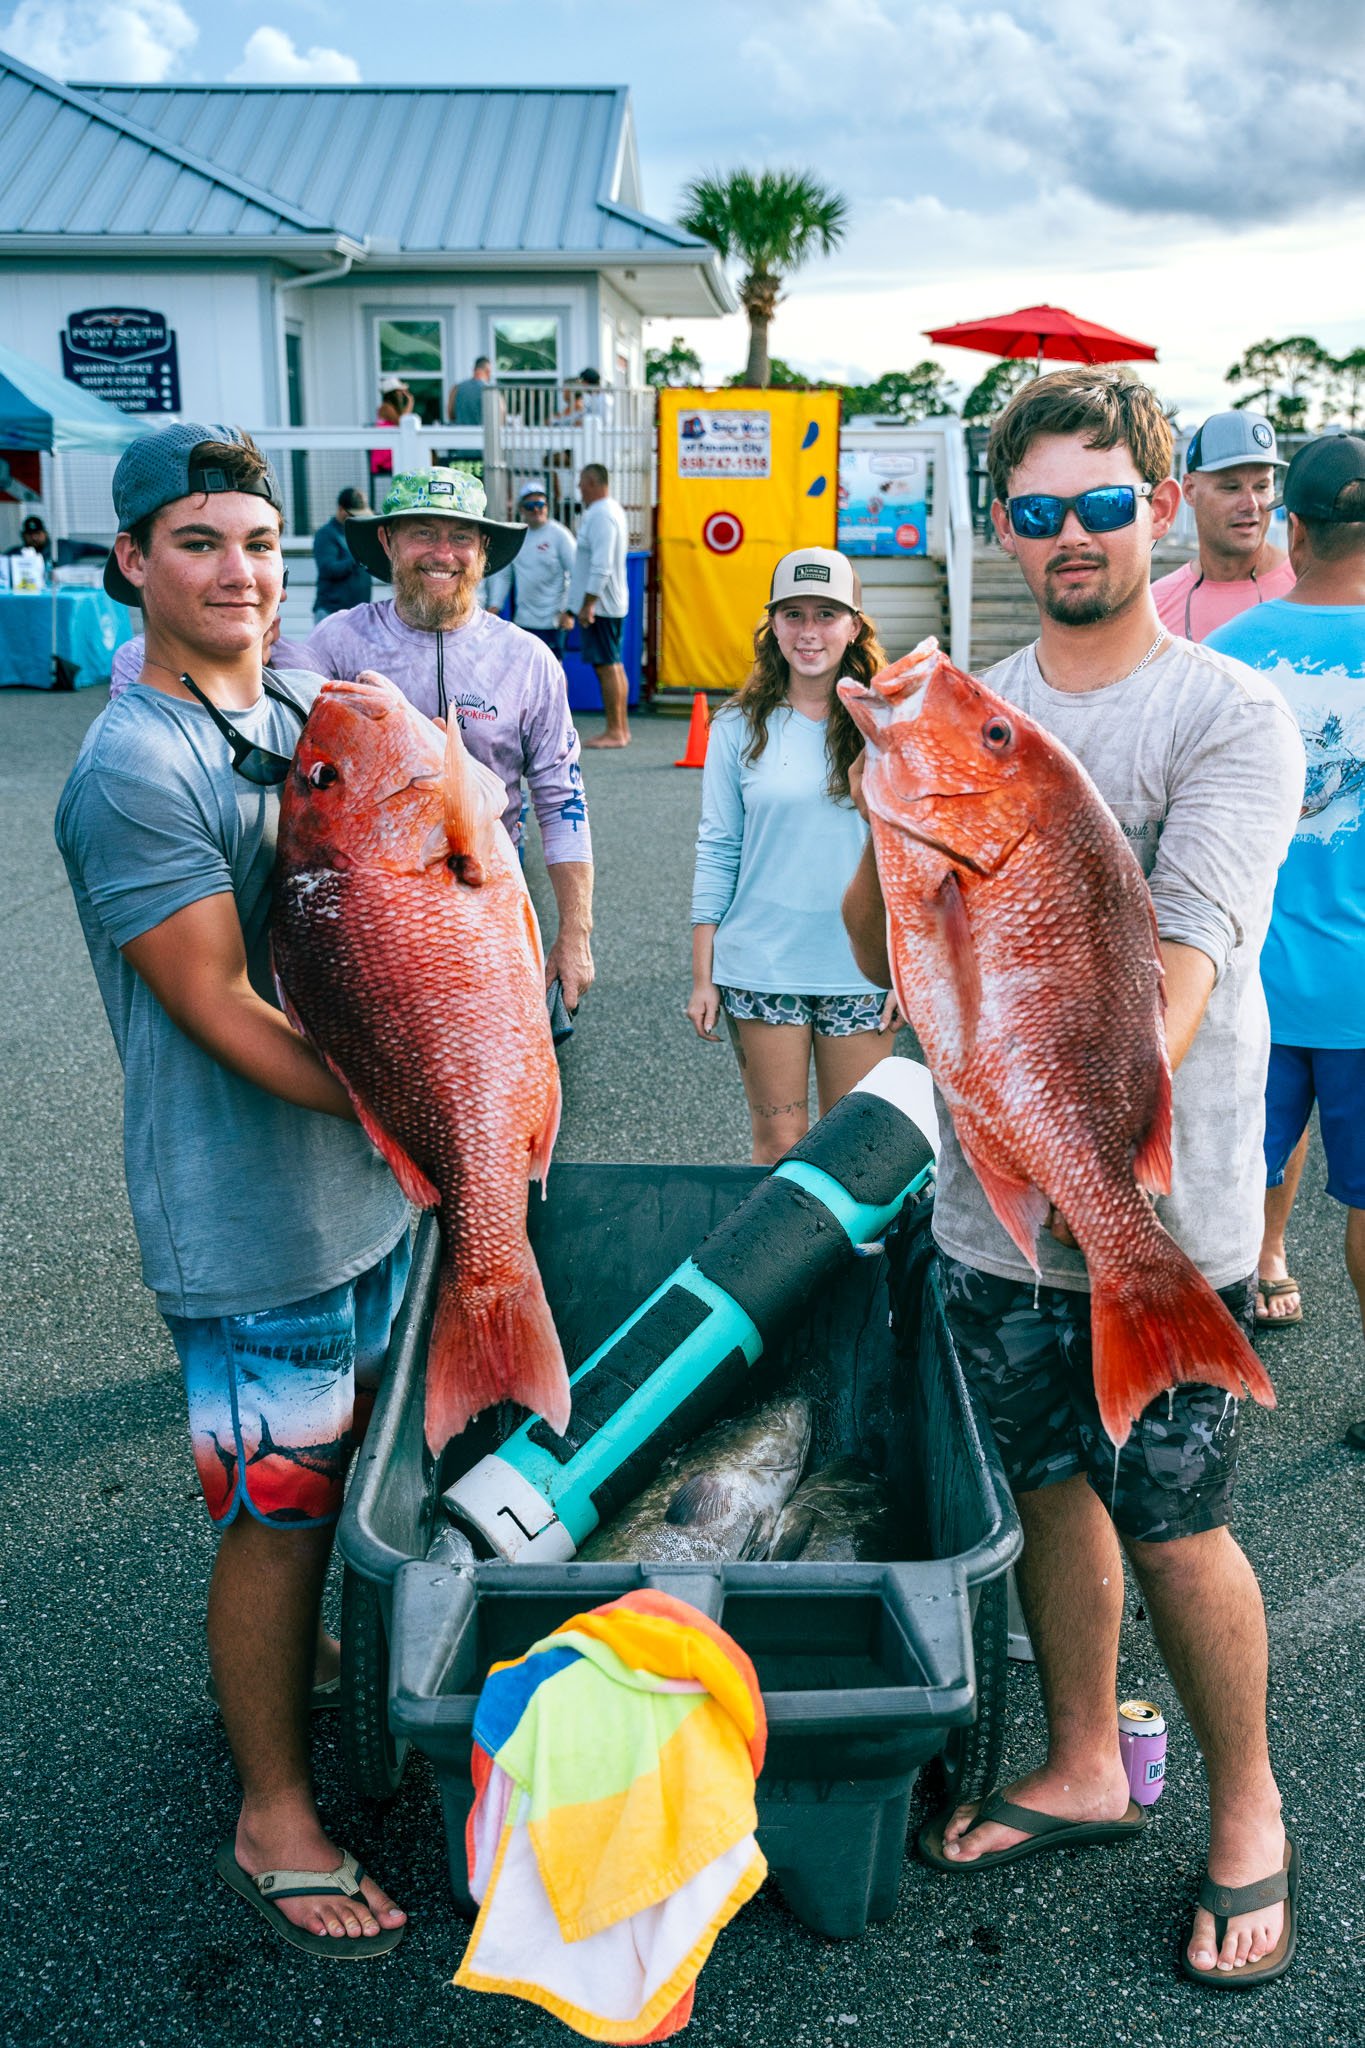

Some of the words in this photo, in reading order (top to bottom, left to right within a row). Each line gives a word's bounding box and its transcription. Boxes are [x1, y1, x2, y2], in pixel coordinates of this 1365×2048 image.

[72, 328, 113, 339] POINT
[116, 327, 163, 339] SOUTH
[73, 364, 115, 373] MARINA
[118, 363, 154, 373] OFFICE
[115, 376, 147, 385] STORE
[685, 443, 696, 452] of
[698, 443, 739, 452] Panama
[742, 443, 763, 453] City
